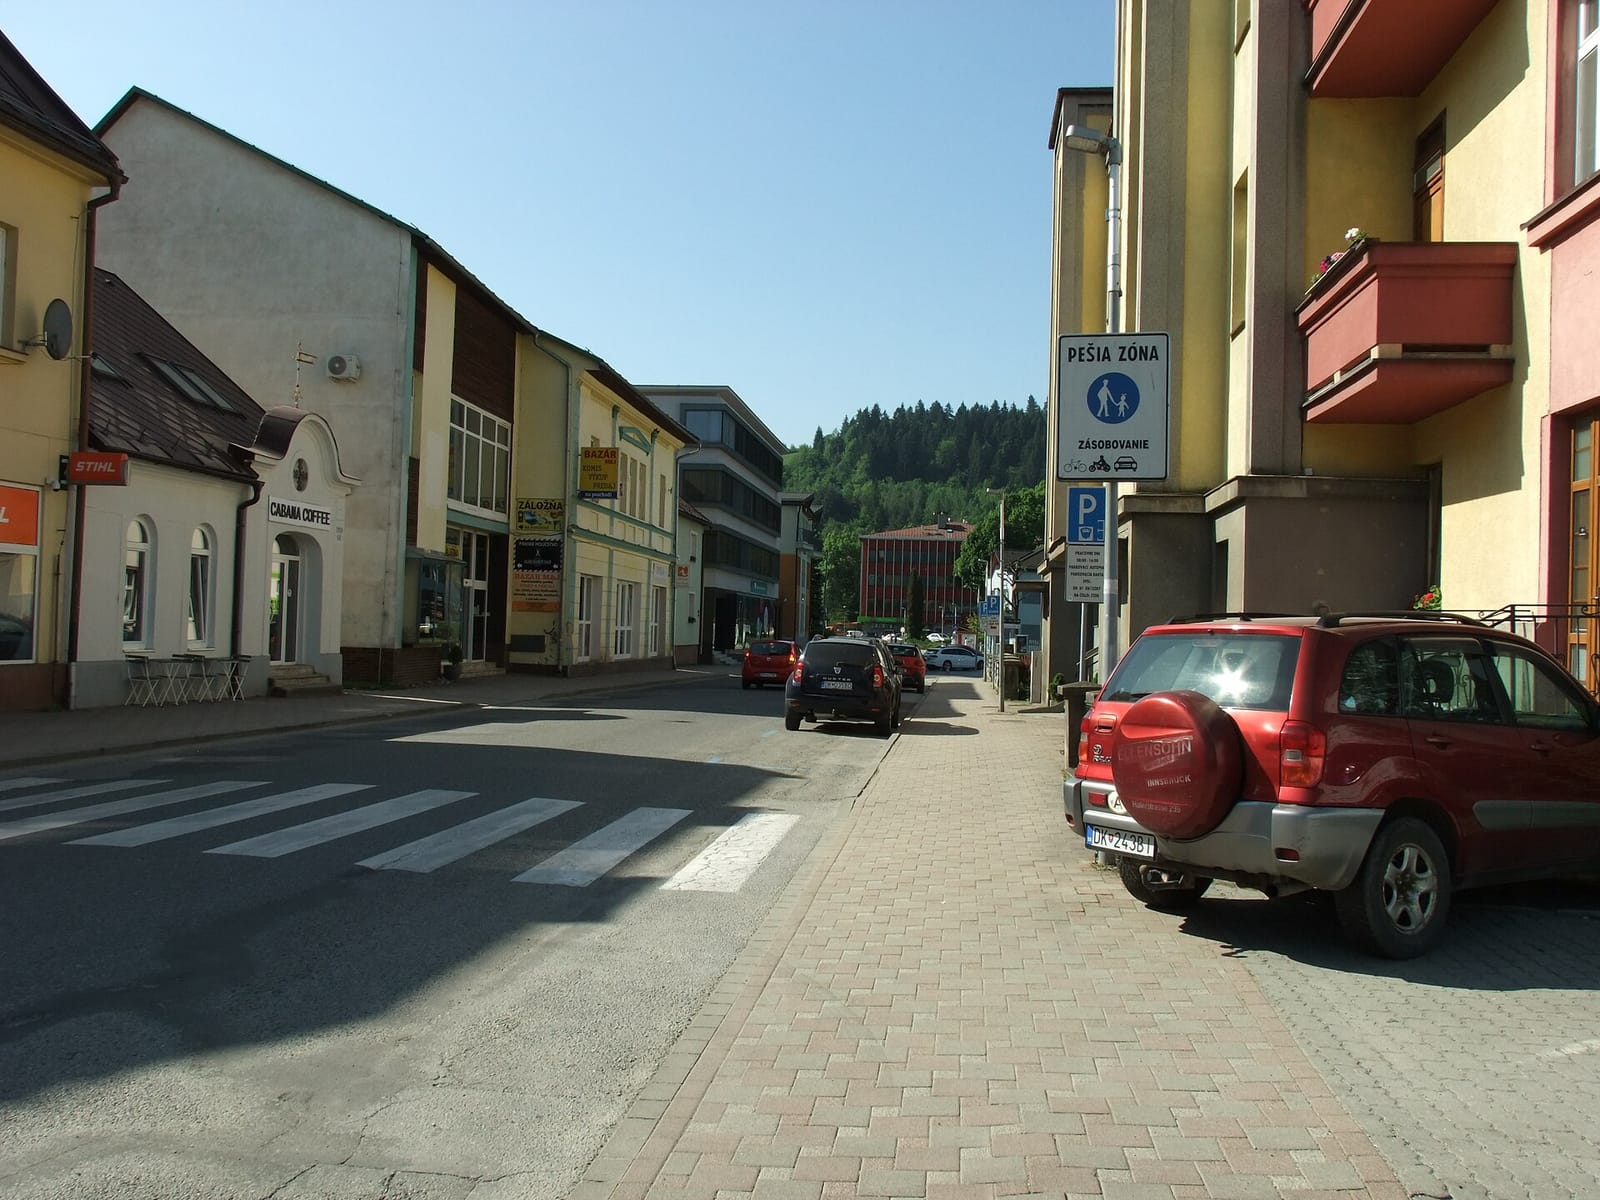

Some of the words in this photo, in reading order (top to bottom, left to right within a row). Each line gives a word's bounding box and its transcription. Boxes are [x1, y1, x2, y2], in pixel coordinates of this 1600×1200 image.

[1068, 343, 1111, 362] PEŠIA
[1118, 341, 1159, 361] ZÓNA
[1078, 437, 1149, 450] ZÁSOBOVANIE
[584, 449, 616, 459] BAZÁR
[75, 460, 116, 473] STIHL
[270, 502, 301, 520] CABANA
[302, 508, 331, 525] COFFEE
[1078, 494, 1097, 525] P
